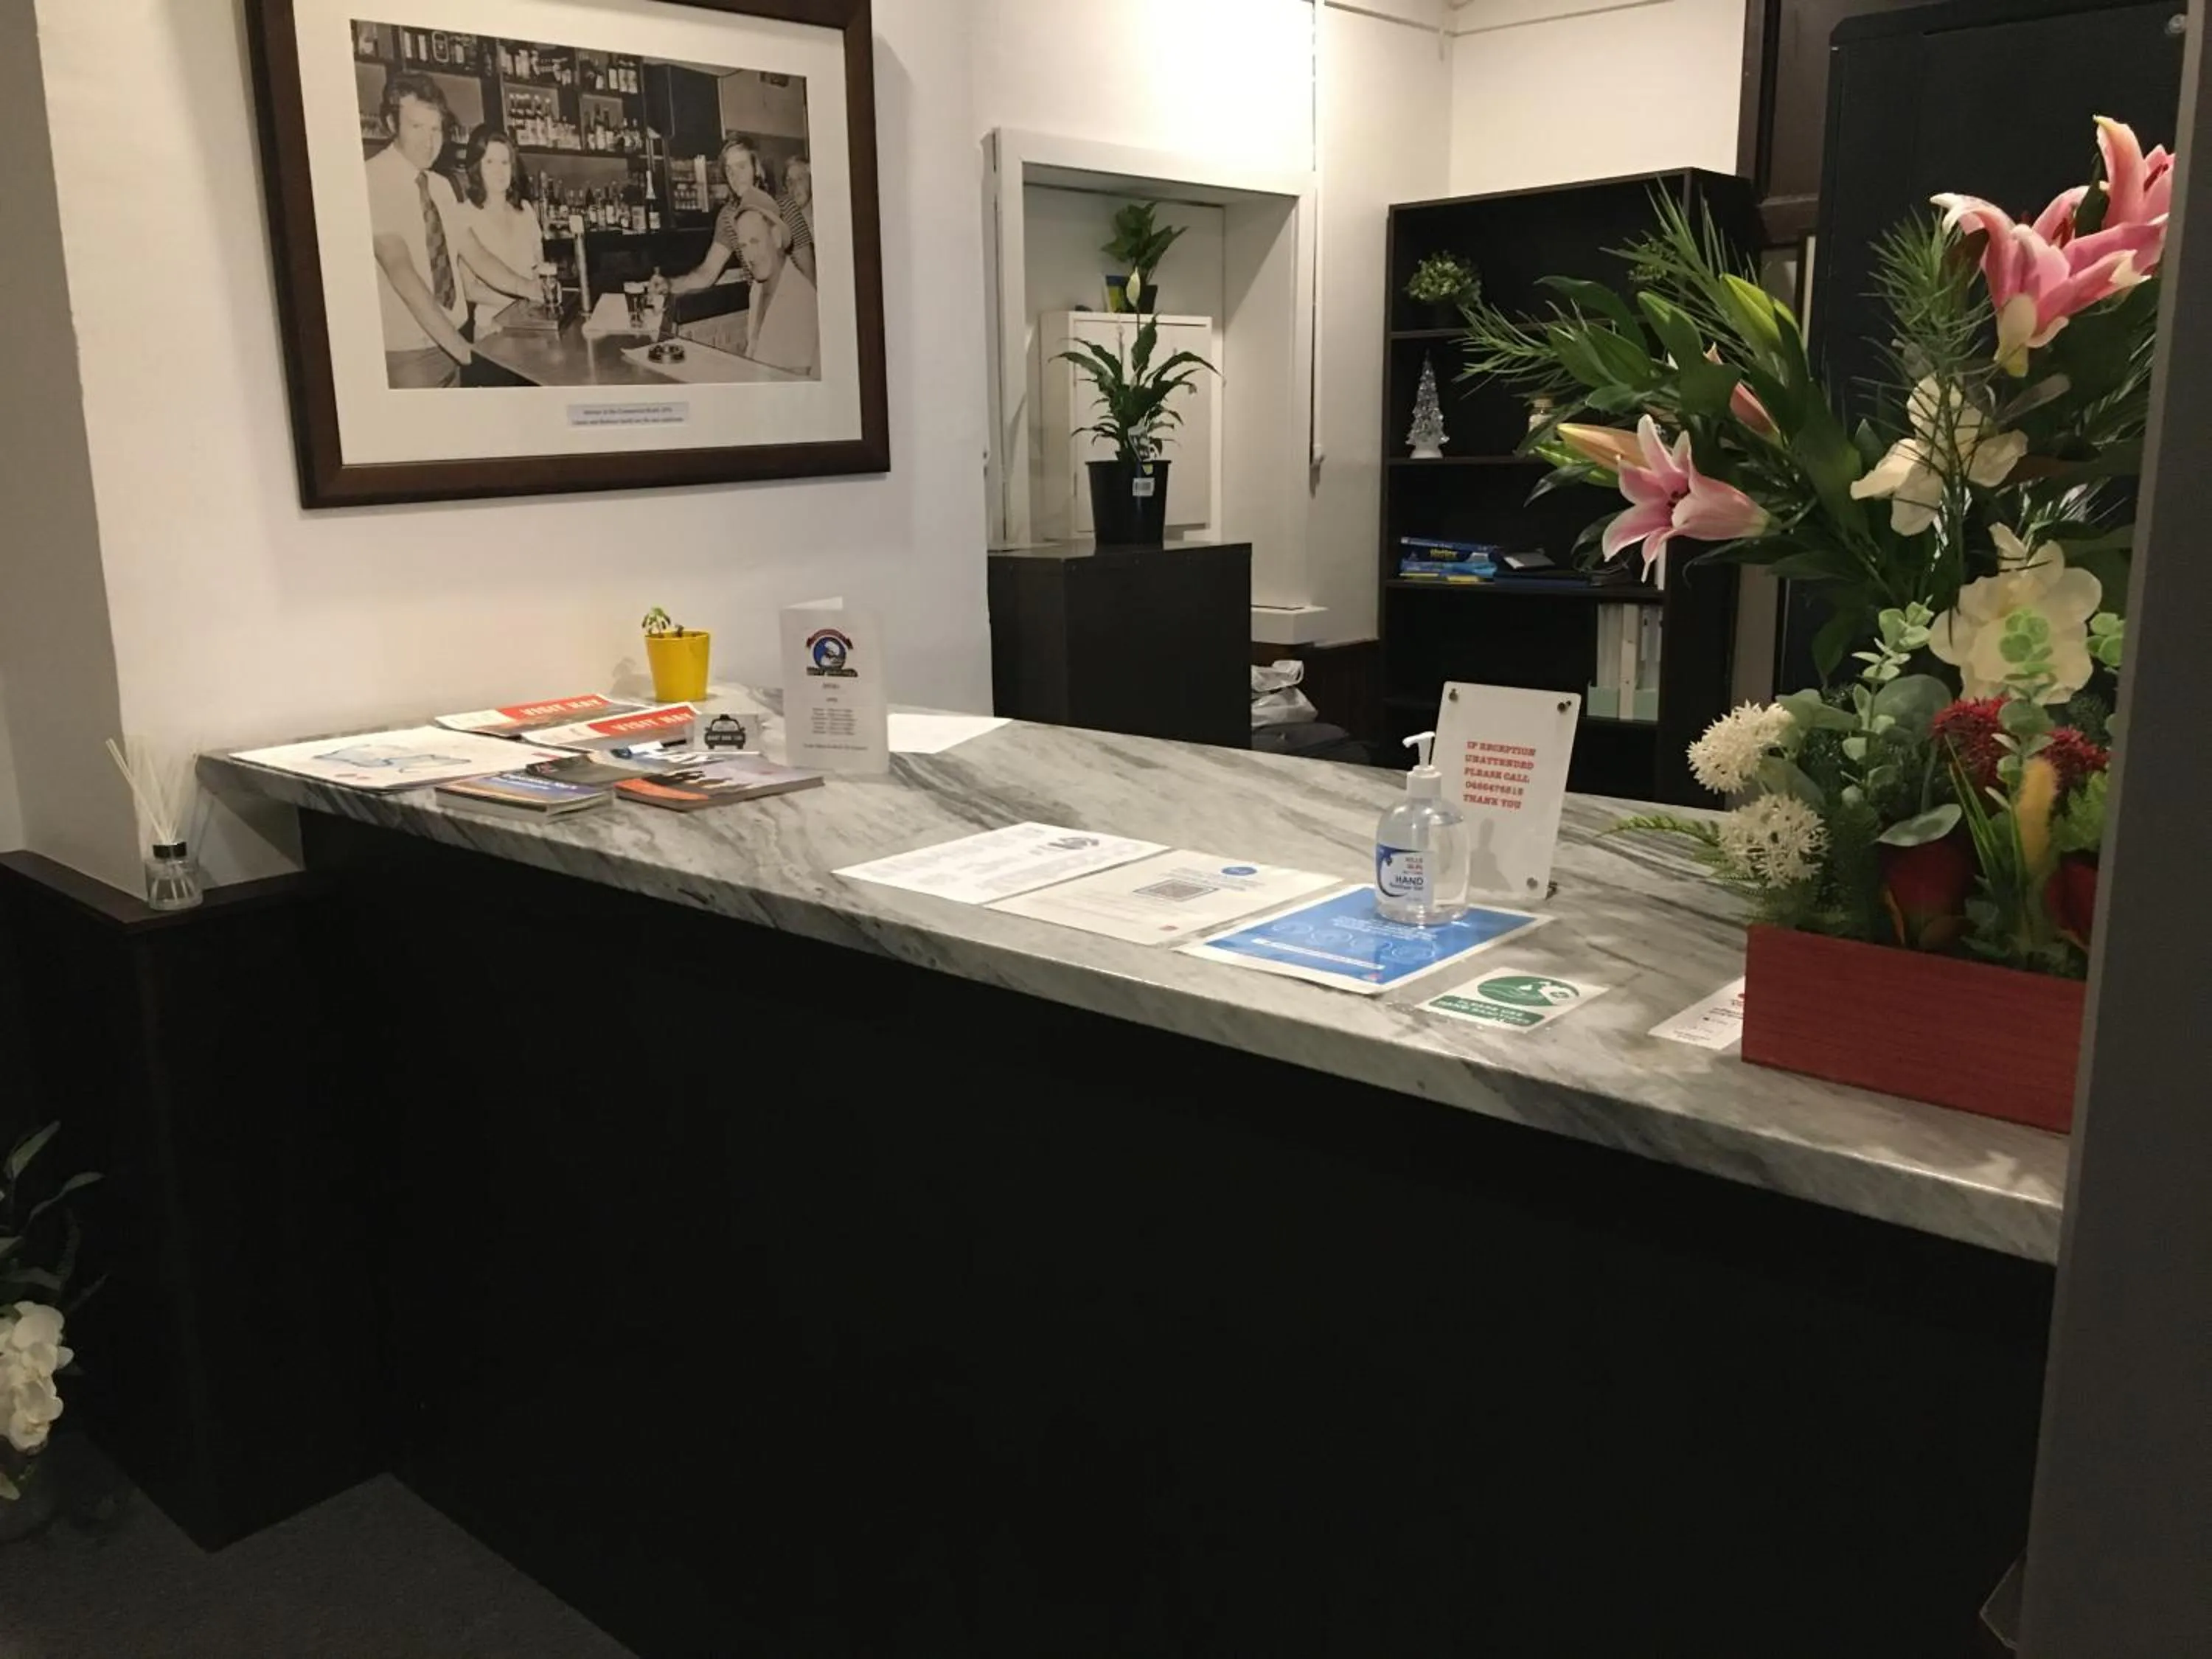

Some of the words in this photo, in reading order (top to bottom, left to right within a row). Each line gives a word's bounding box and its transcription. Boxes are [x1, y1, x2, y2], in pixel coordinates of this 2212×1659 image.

[518, 704, 566, 716] VISIT
[611, 719, 658, 731] VISIT
[1479, 742, 1536, 756] RECEPTION
[1464, 754, 1534, 770] UNATTENDED
[1464, 767, 1502, 779] PLEASE
[1463, 794, 1499, 806] THANK
[1501, 799, 1522, 810] YOU
[1395, 875, 1424, 886] HAND
